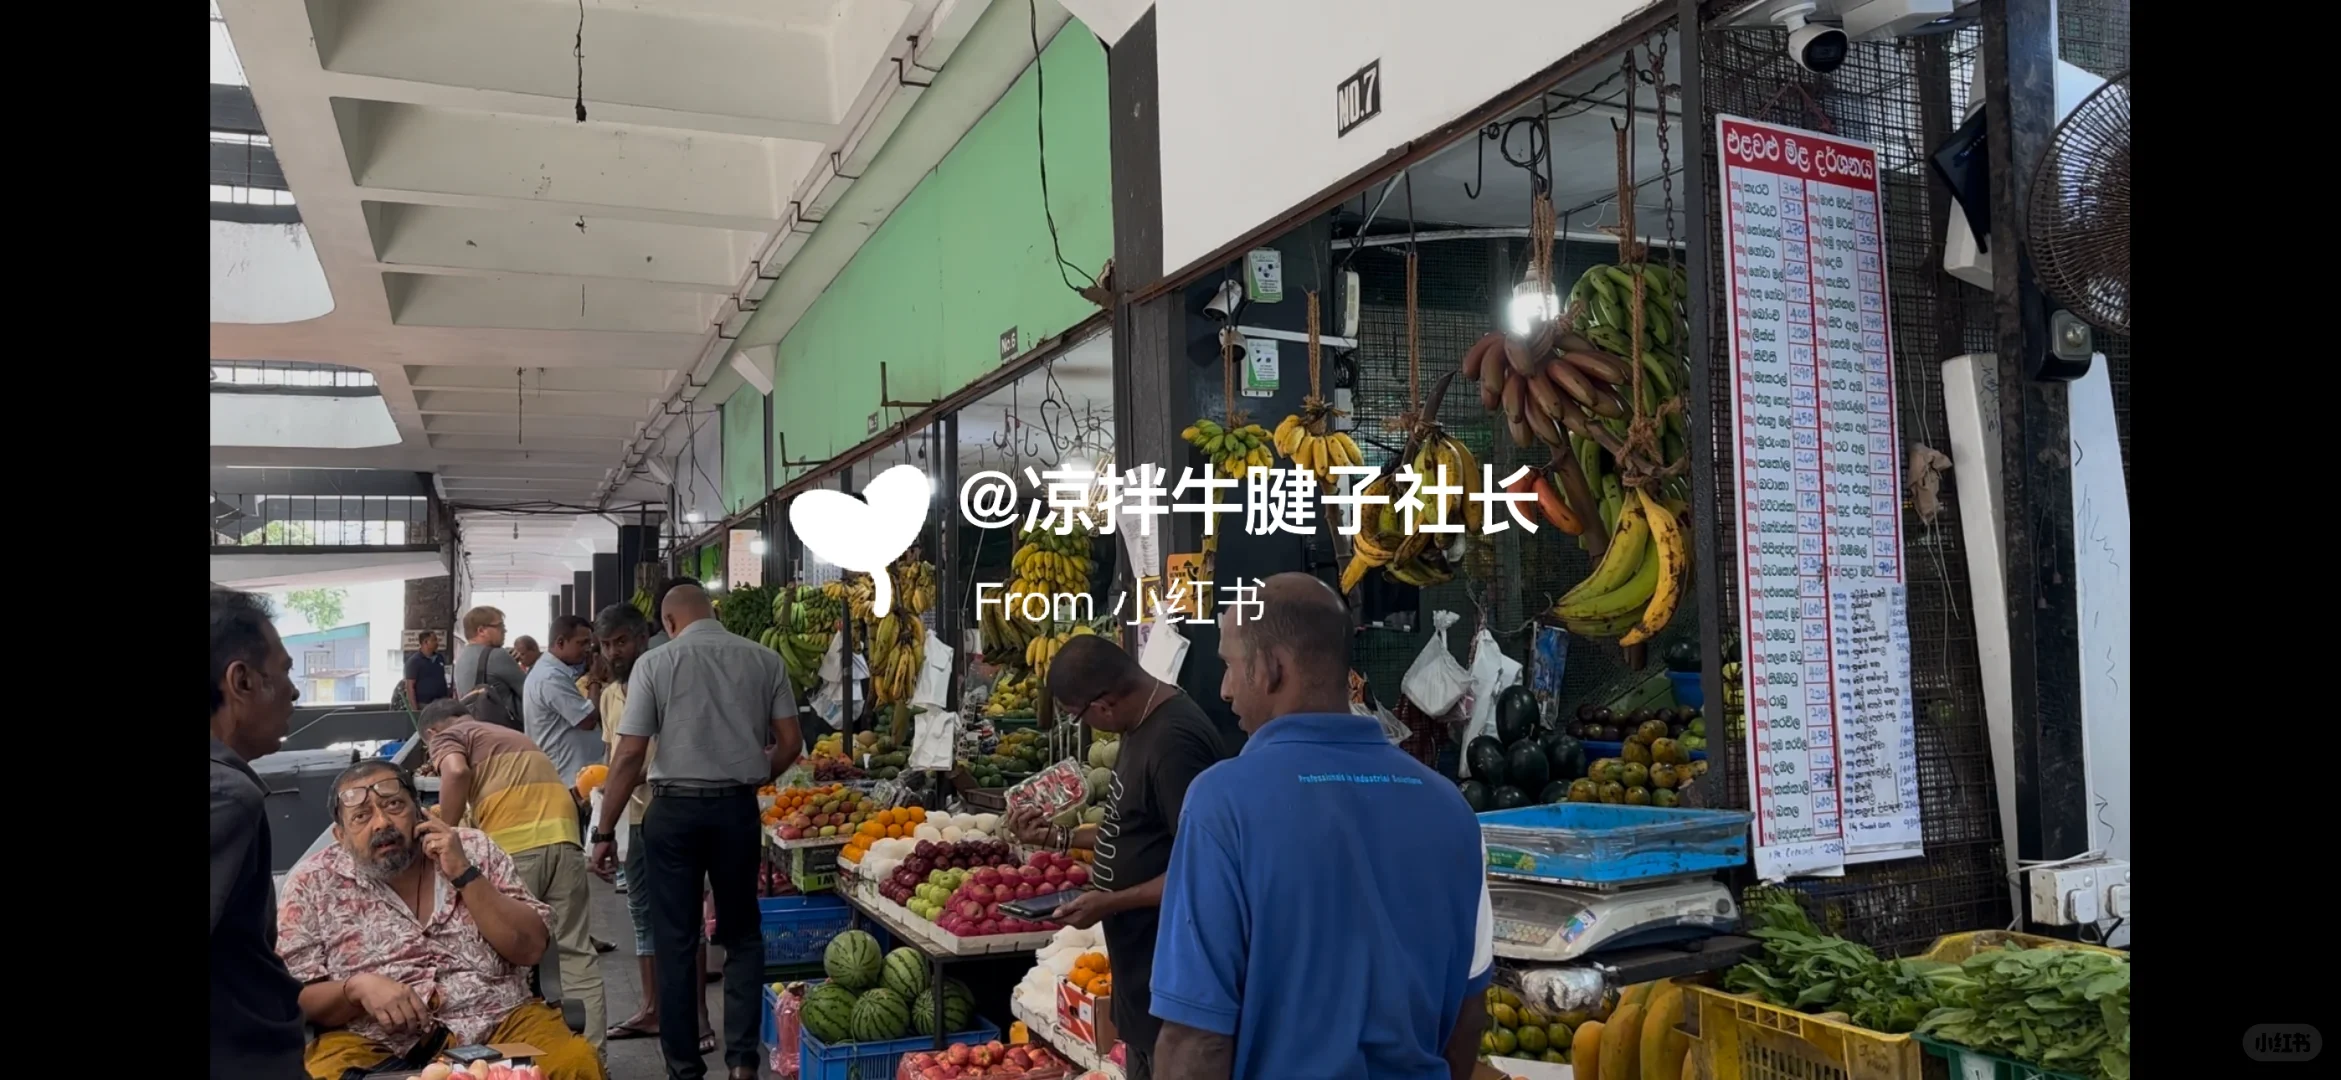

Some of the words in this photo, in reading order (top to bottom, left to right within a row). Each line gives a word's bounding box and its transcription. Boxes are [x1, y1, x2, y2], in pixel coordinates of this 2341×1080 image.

[1338, 66, 1377, 131] NO.7
[1727, 128, 1780, 162] එළවළු
[1785, 138, 1811, 173] මිල
[1815, 145, 1873, 180] දර්ශනය
[1744, 183, 1769, 196] කැරට්
[1752, 308, 1780, 321] බෝංචි
[1855, 423, 1867, 436] අල
[1835, 440, 1849, 453] රට
[1851, 443, 1865, 456] අල
[1766, 629, 1796, 643] වම්බටු
[1790, 651, 1803, 665] බටු
[1769, 694, 1788, 709] රාබු
[1770, 715, 1800, 730] කරවිල
[1785, 736, 1808, 752] කරවිල
[1298, 773, 1345, 783] Professionals
[1353, 774, 1390, 784] Industrial
[1391, 774, 1423, 785] Solutions
[1774, 780, 1809, 796] තක්කාලි
[1776, 805, 1800, 818] බතල
